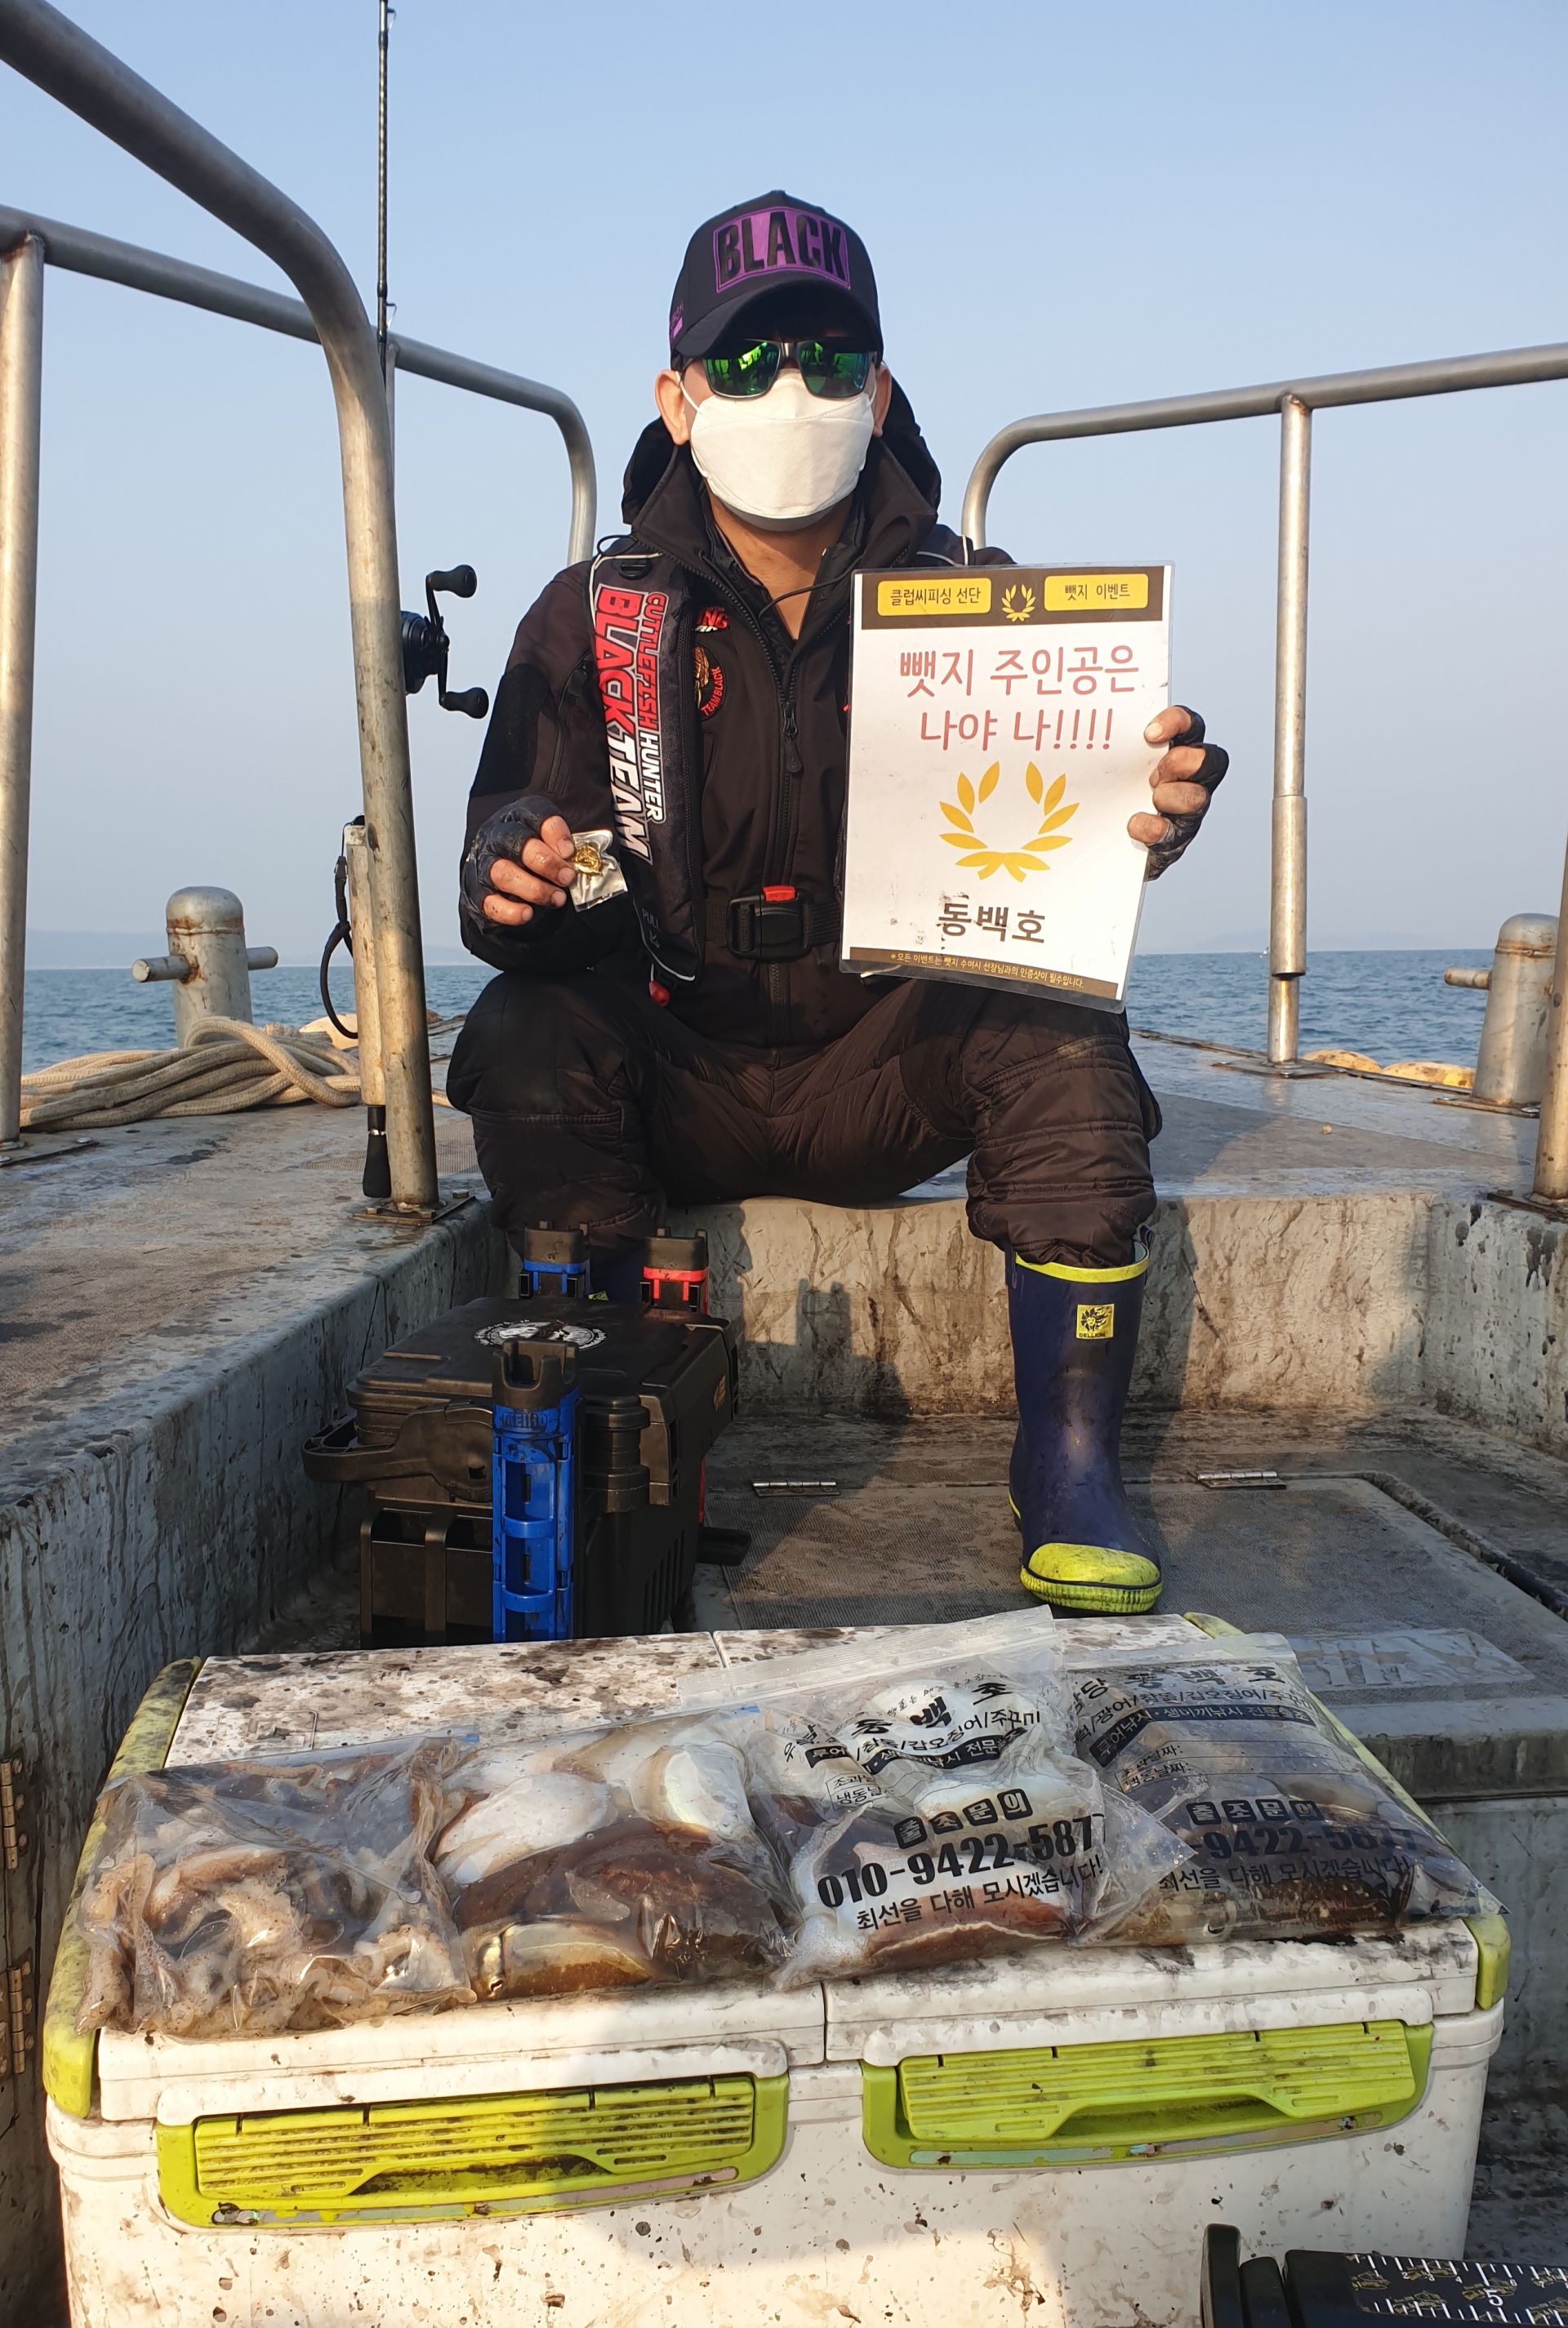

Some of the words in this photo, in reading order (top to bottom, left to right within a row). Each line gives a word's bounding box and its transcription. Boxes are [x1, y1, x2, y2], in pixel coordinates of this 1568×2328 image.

[717, 212, 846, 283] BLACK
[890, 587, 951, 606] 클럽씨피싱
[956, 586, 981, 604] 선단
[1064, 583, 1088, 601] 뺏지
[1096, 582, 1131, 600] 이벤트
[595, 587, 643, 734] BLACK
[638, 593, 666, 730] CUTTLEFISH
[900, 649, 973, 698] 뺏지
[990, 645, 1139, 696] 주인공은
[701, 698, 721, 716] TEAM
[711, 666, 724, 698] BLACK
[920, 710, 998, 751] 나야
[1013, 708, 1113, 751] 나!!!!
[608, 734, 650, 858] TEAM
[639, 731, 663, 822] HUNTER
[938, 903, 1045, 943] 동백호
[913, 955, 942, 966] 이벤트는
[960, 959, 982, 970] 수여시
[983, 961, 1018, 976] 선장님과의
[1020, 967, 1048, 981] 인증샷이
[1049, 973, 1085, 989] 필수입니다.
[1158, 1866, 1222, 1893] 최선을
[1227, 1863, 1271, 1884] 다해
[857, 1897, 923, 1931] 최선을
[930, 1885, 975, 1915] 다해
[1402, 2272, 1410, 2280] 2
[1454, 2276, 1463, 2284] 4
[1509, 2278, 1518, 2287] 6
[1483, 2288, 1503, 2307] 5
